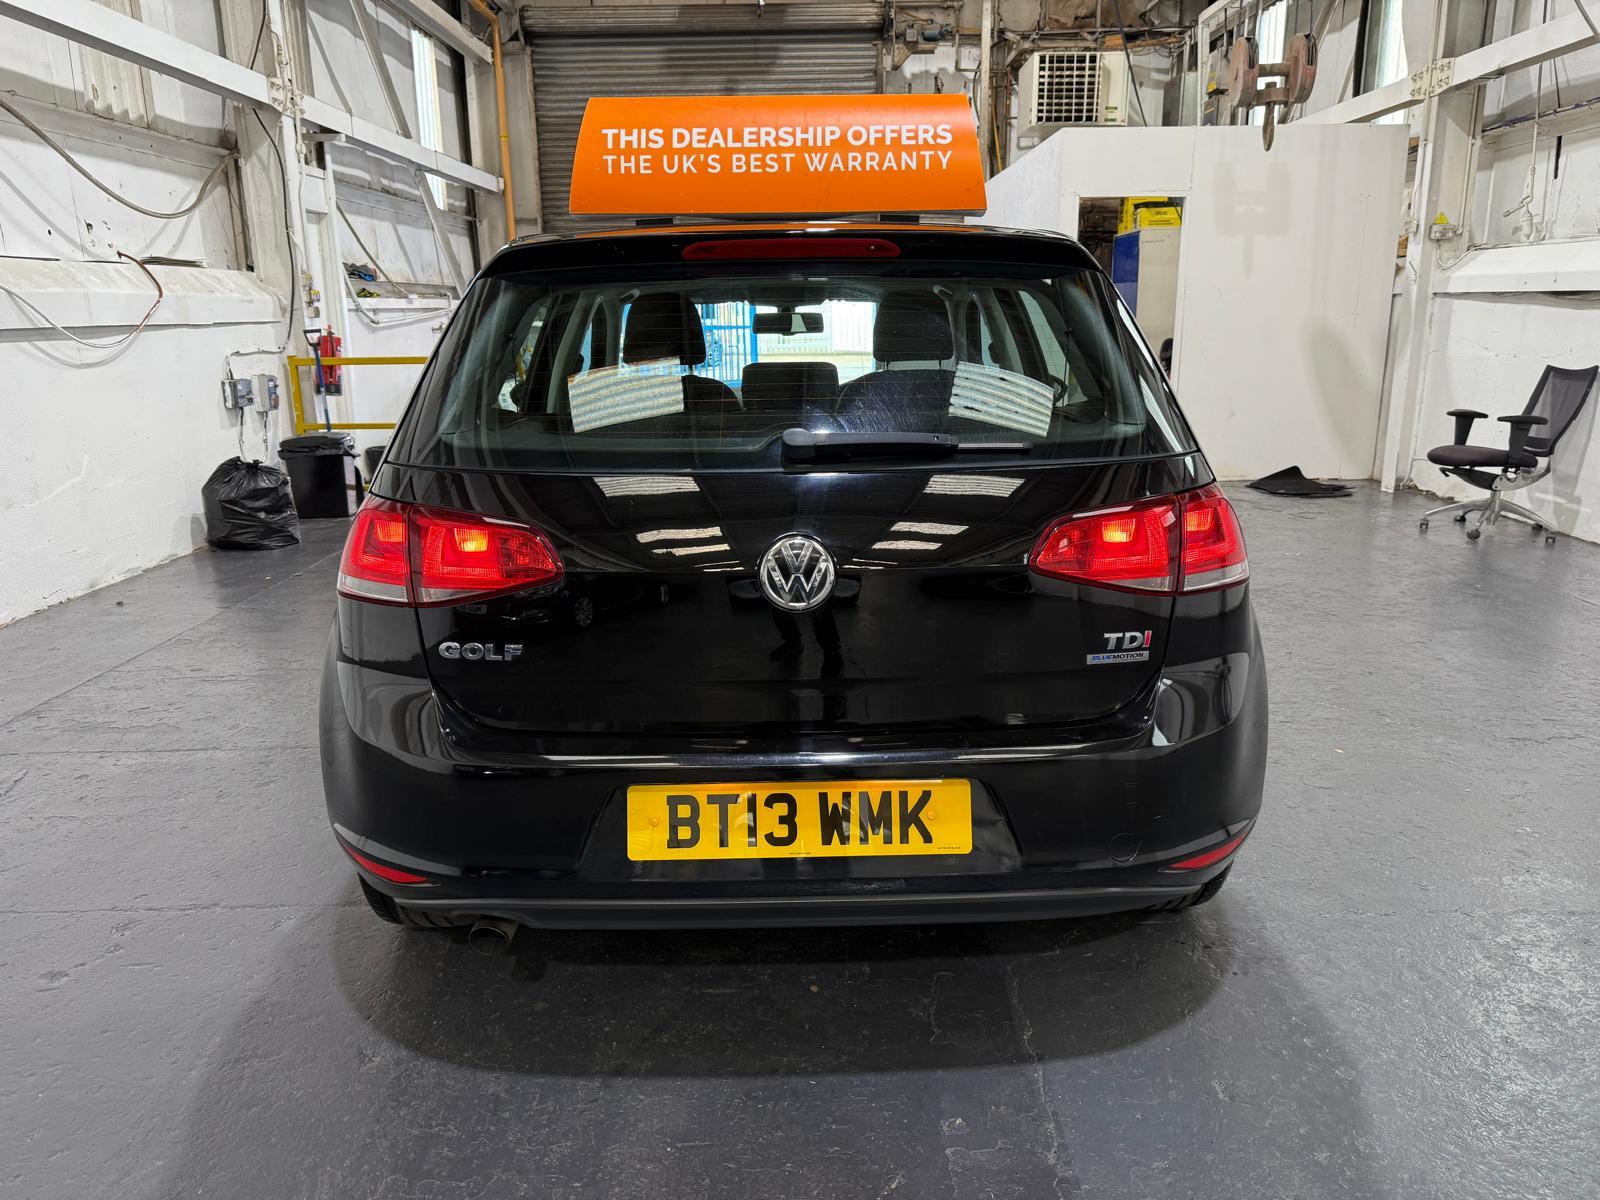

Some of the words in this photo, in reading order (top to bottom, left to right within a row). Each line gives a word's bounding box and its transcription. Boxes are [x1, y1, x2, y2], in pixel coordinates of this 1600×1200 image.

[601, 127, 664, 149] THIS
[671, 125, 841, 149] DEALERSHIP
[847, 124, 953, 147] OFFERS
[602, 154, 653, 175] THE
[662, 153, 722, 174] UK'S
[731, 152, 796, 173] BEST
[803, 150, 953, 173] WARRANTY
[438, 641, 523, 661] GOLF
[1103, 630, 1152, 650] TDI
[1091, 652, 1144, 661] BLUEMOTION
[666, 792, 798, 849] BT13
[818, 789, 933, 847] WMK
